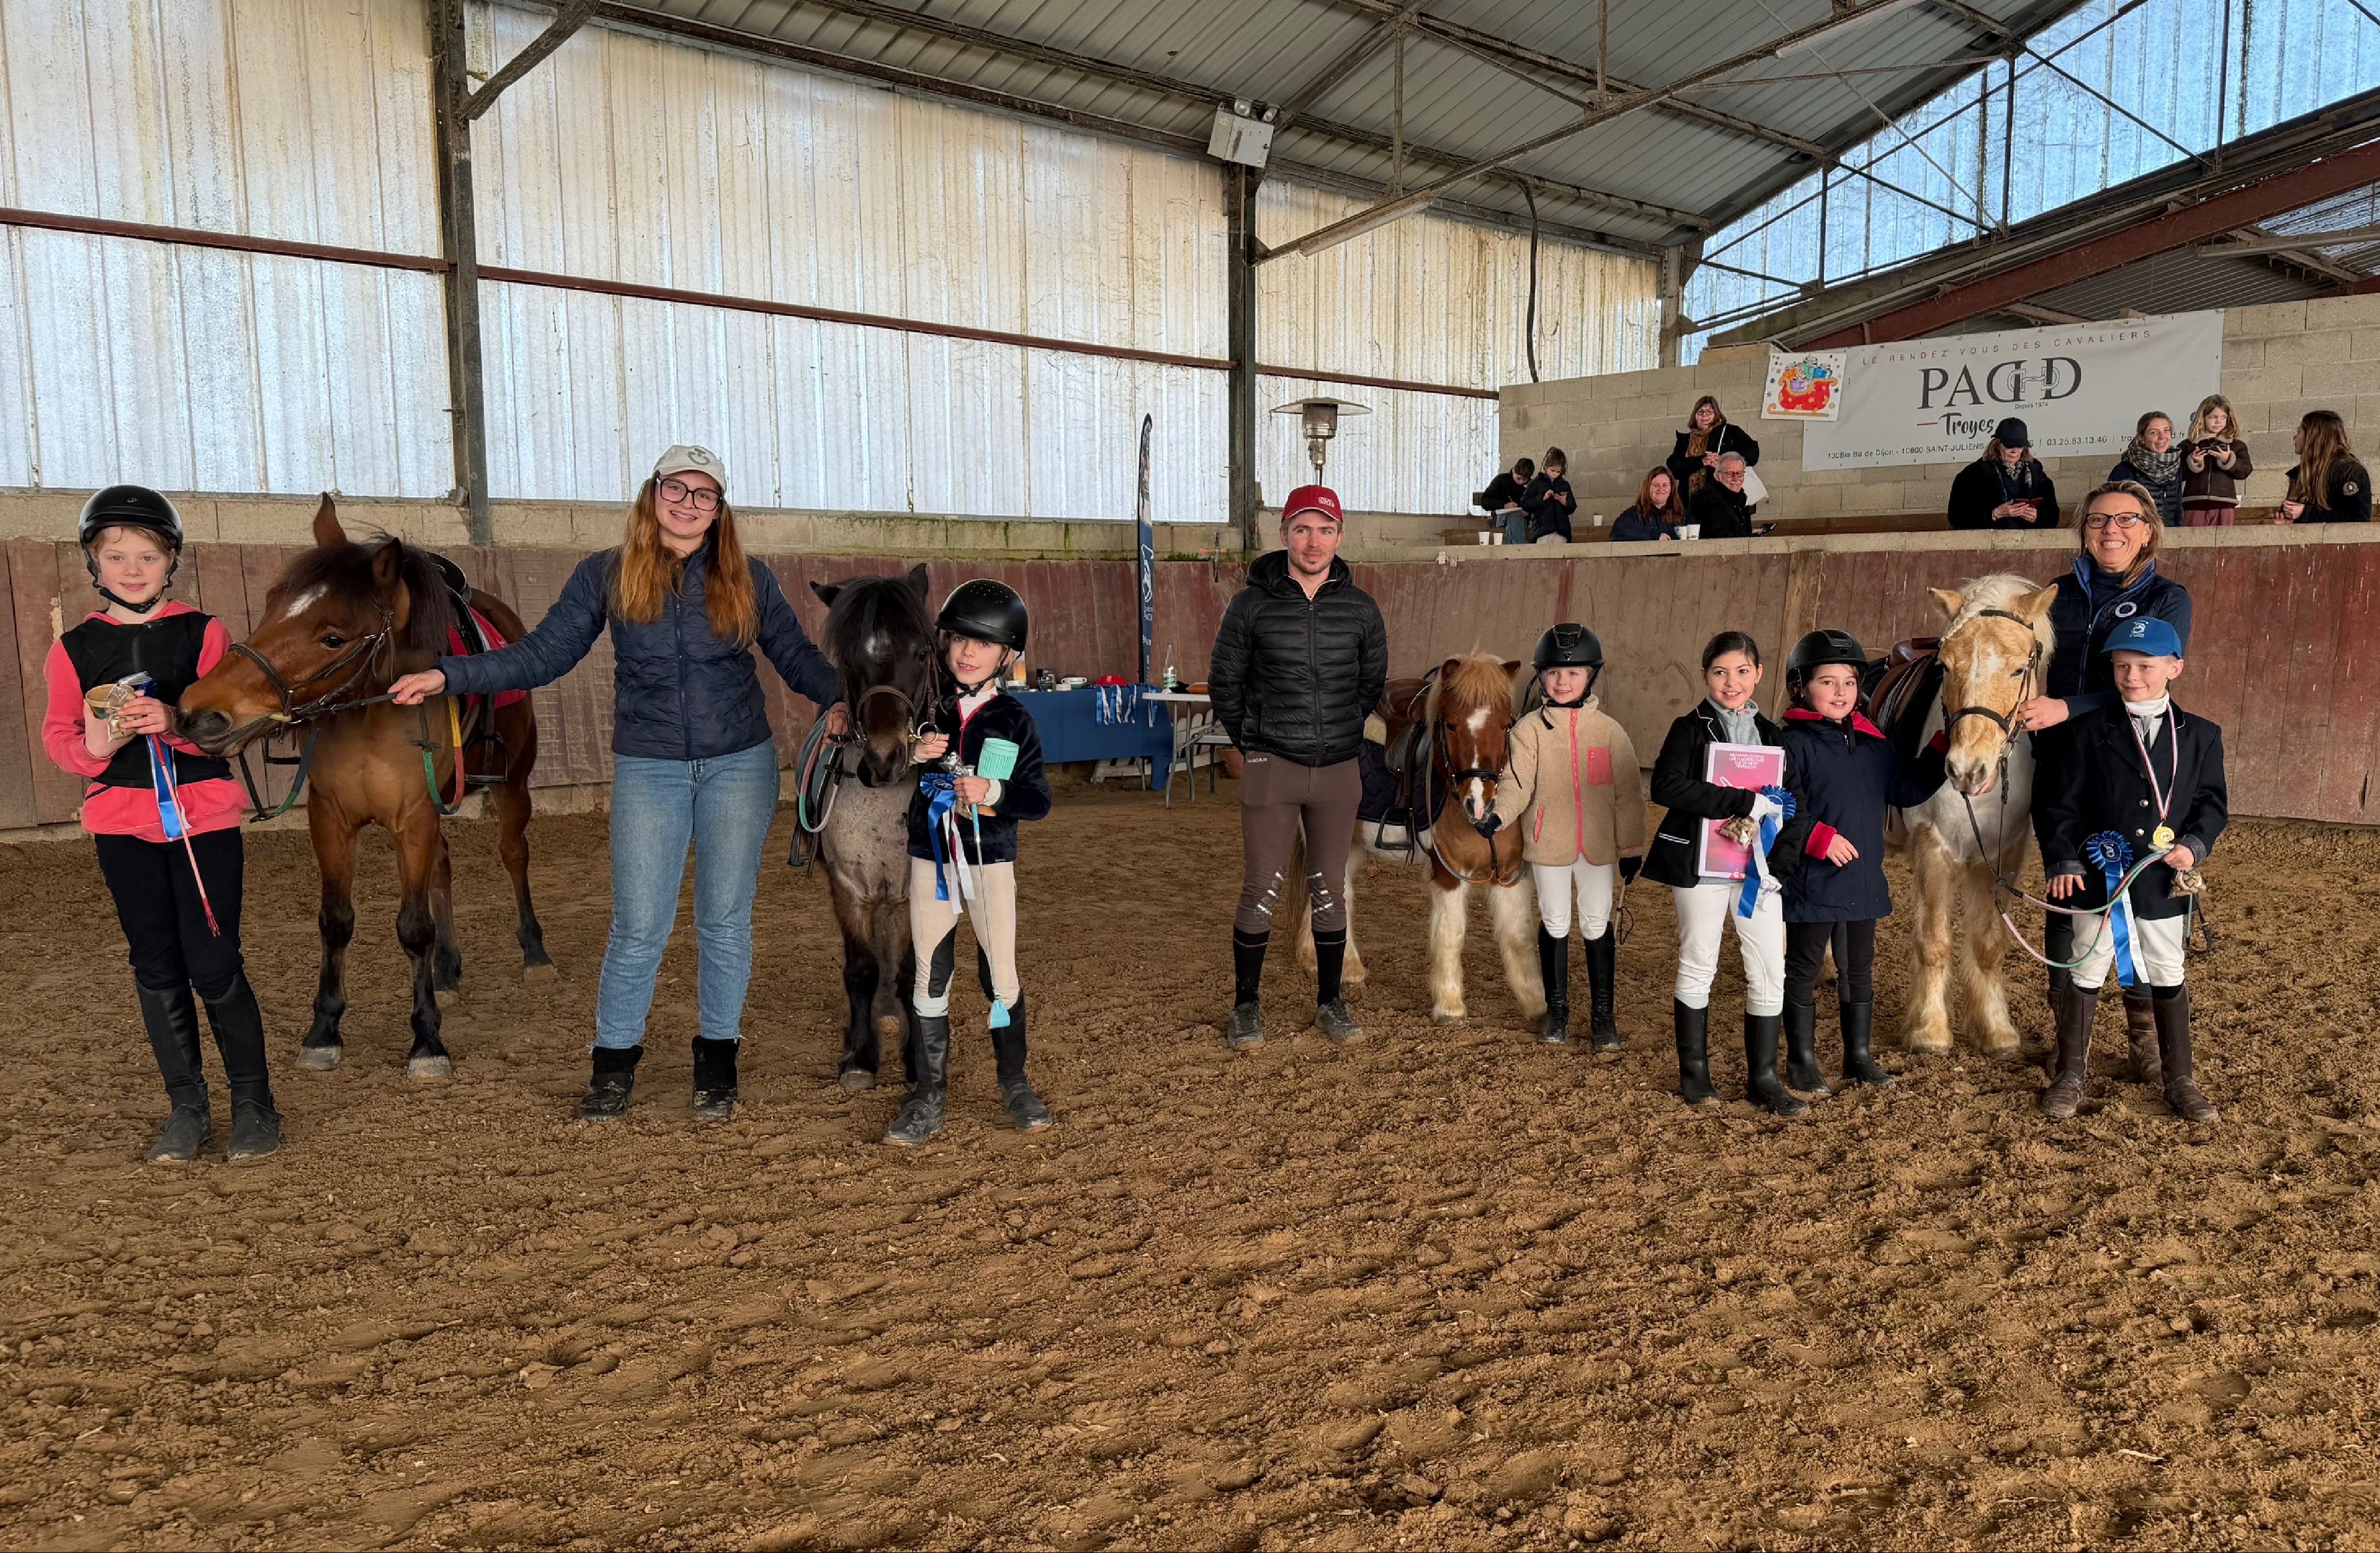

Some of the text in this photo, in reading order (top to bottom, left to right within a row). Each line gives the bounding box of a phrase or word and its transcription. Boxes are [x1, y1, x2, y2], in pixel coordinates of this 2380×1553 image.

[1863, 330, 2150, 365] LE RENDEZ VOUS DES CAVALIERS
[1938, 412, 1995, 440] Troyes
